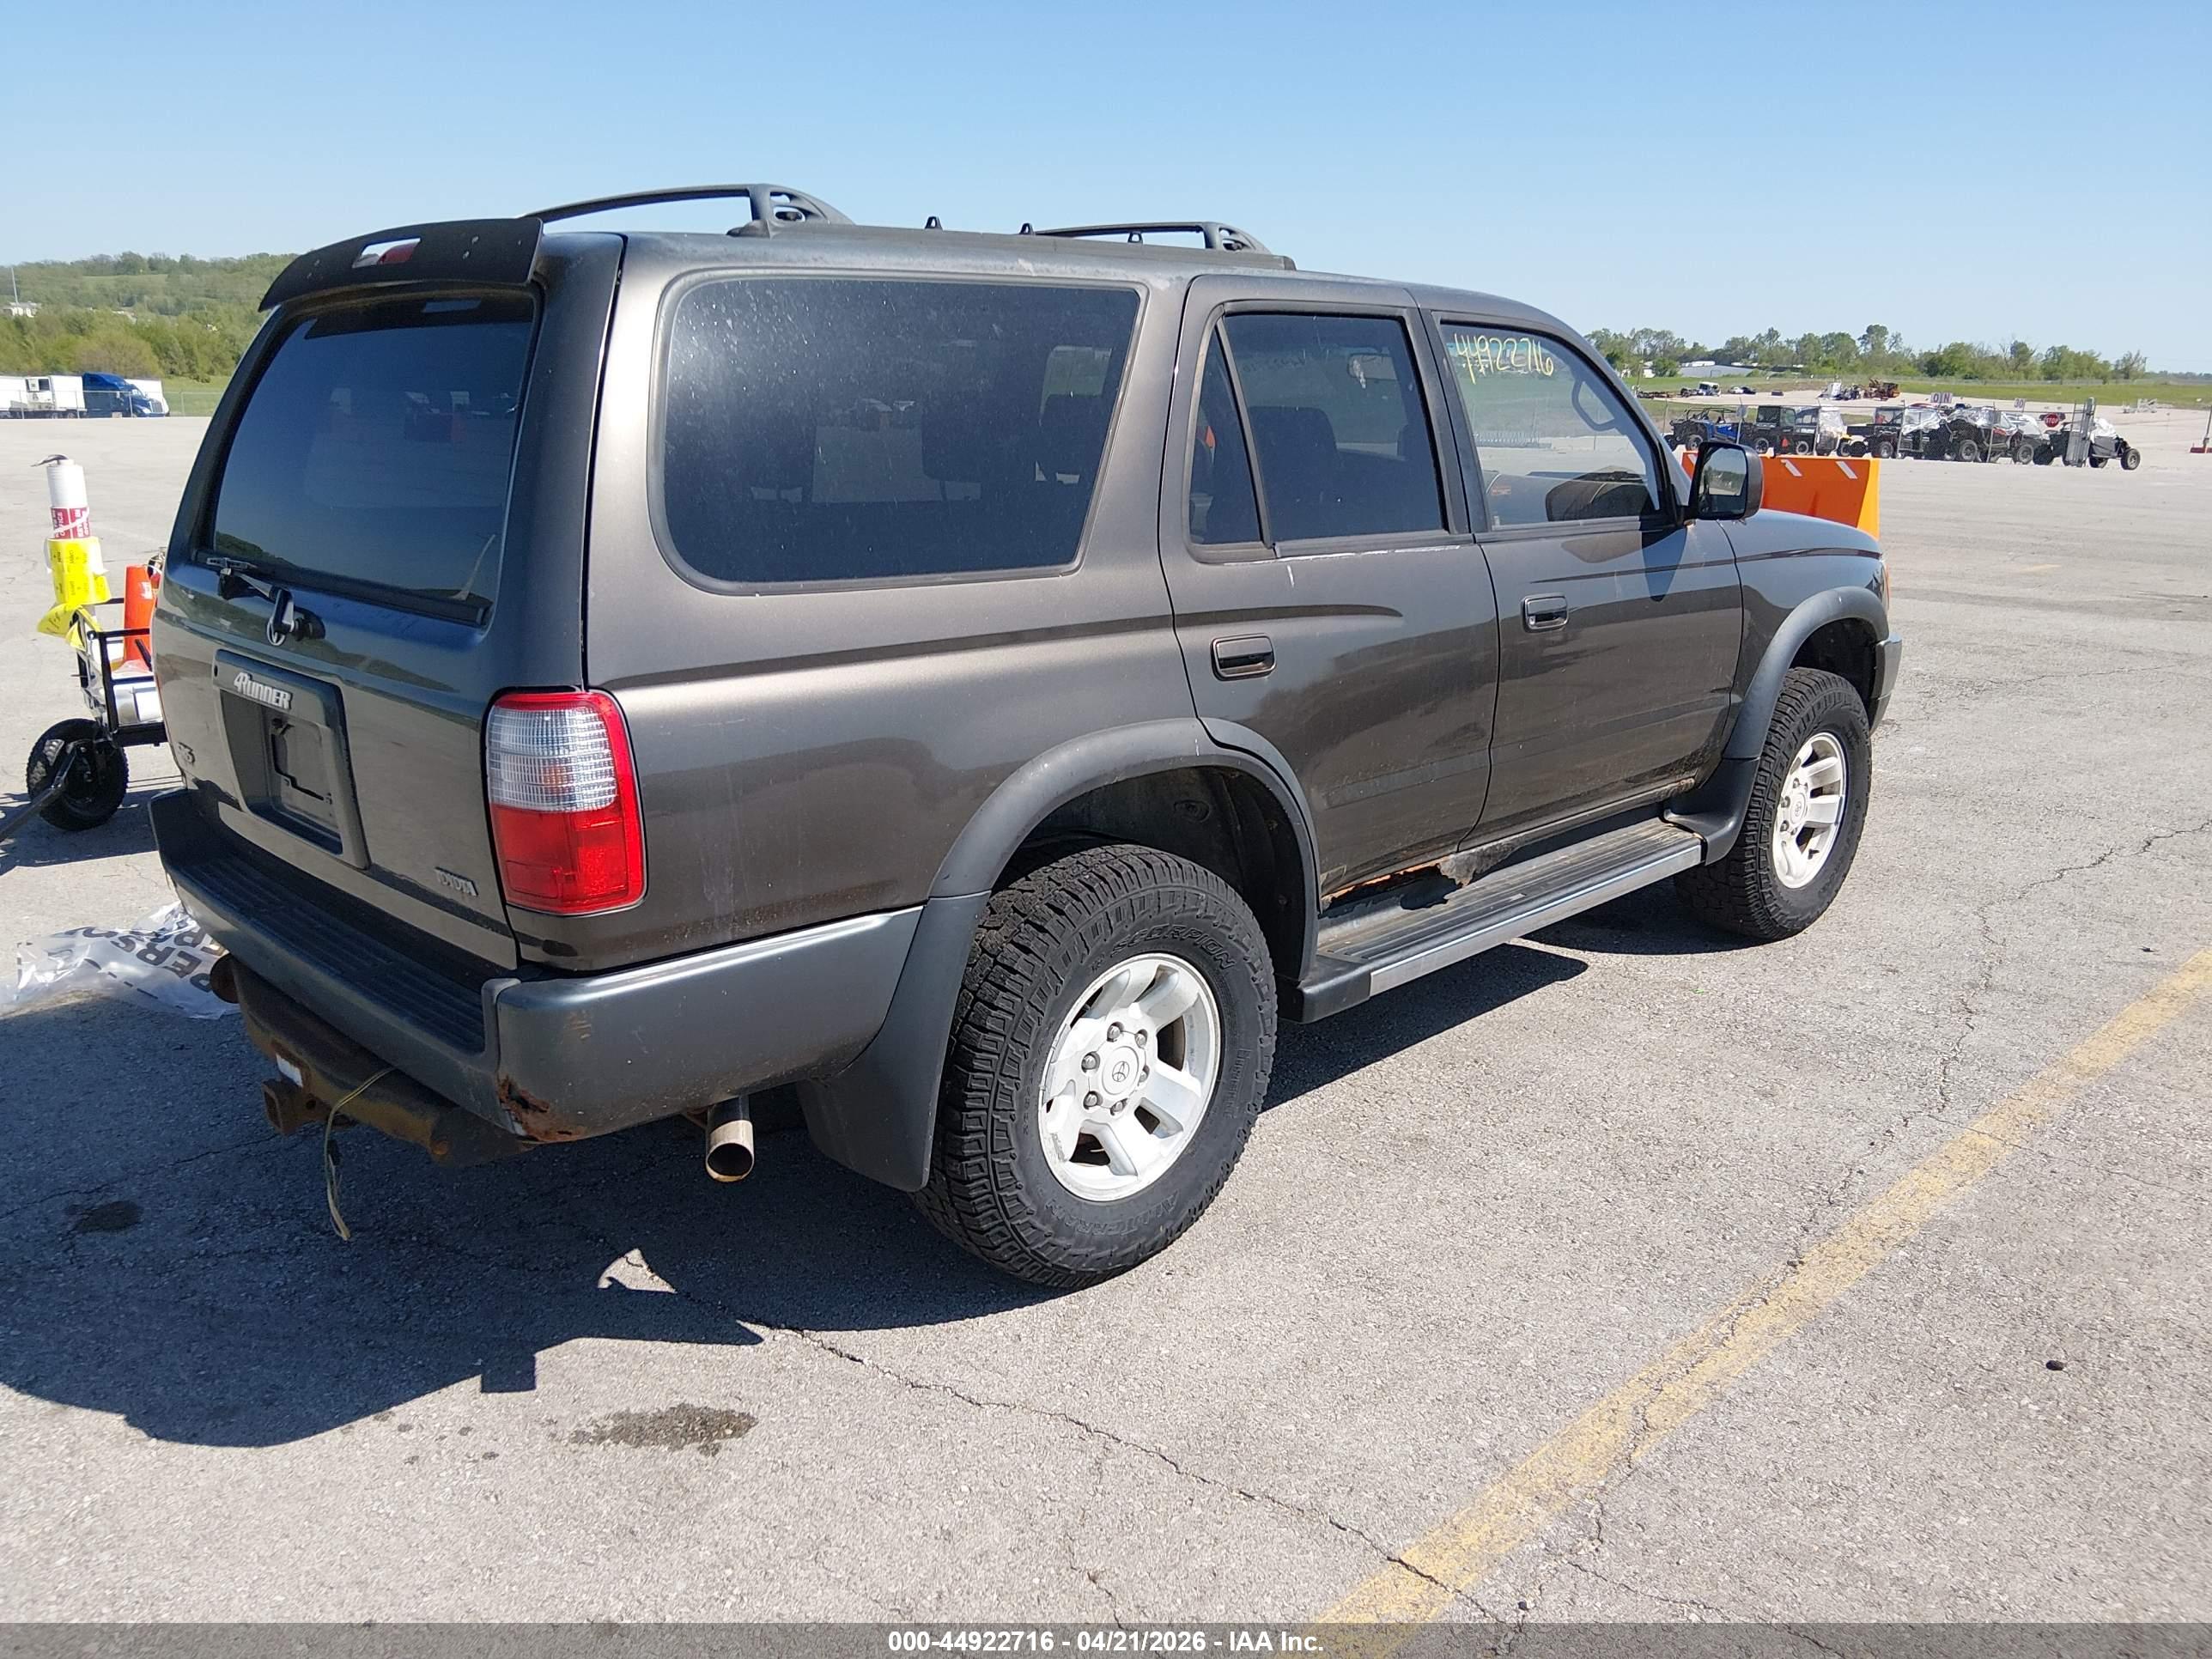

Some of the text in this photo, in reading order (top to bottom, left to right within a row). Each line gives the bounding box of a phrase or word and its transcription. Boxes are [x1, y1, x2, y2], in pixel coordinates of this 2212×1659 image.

[1454, 333, 1554, 385] 44922716
[434, 867, 478, 896] TOYOTA
[1110, 922, 1237, 970] SCORPION
